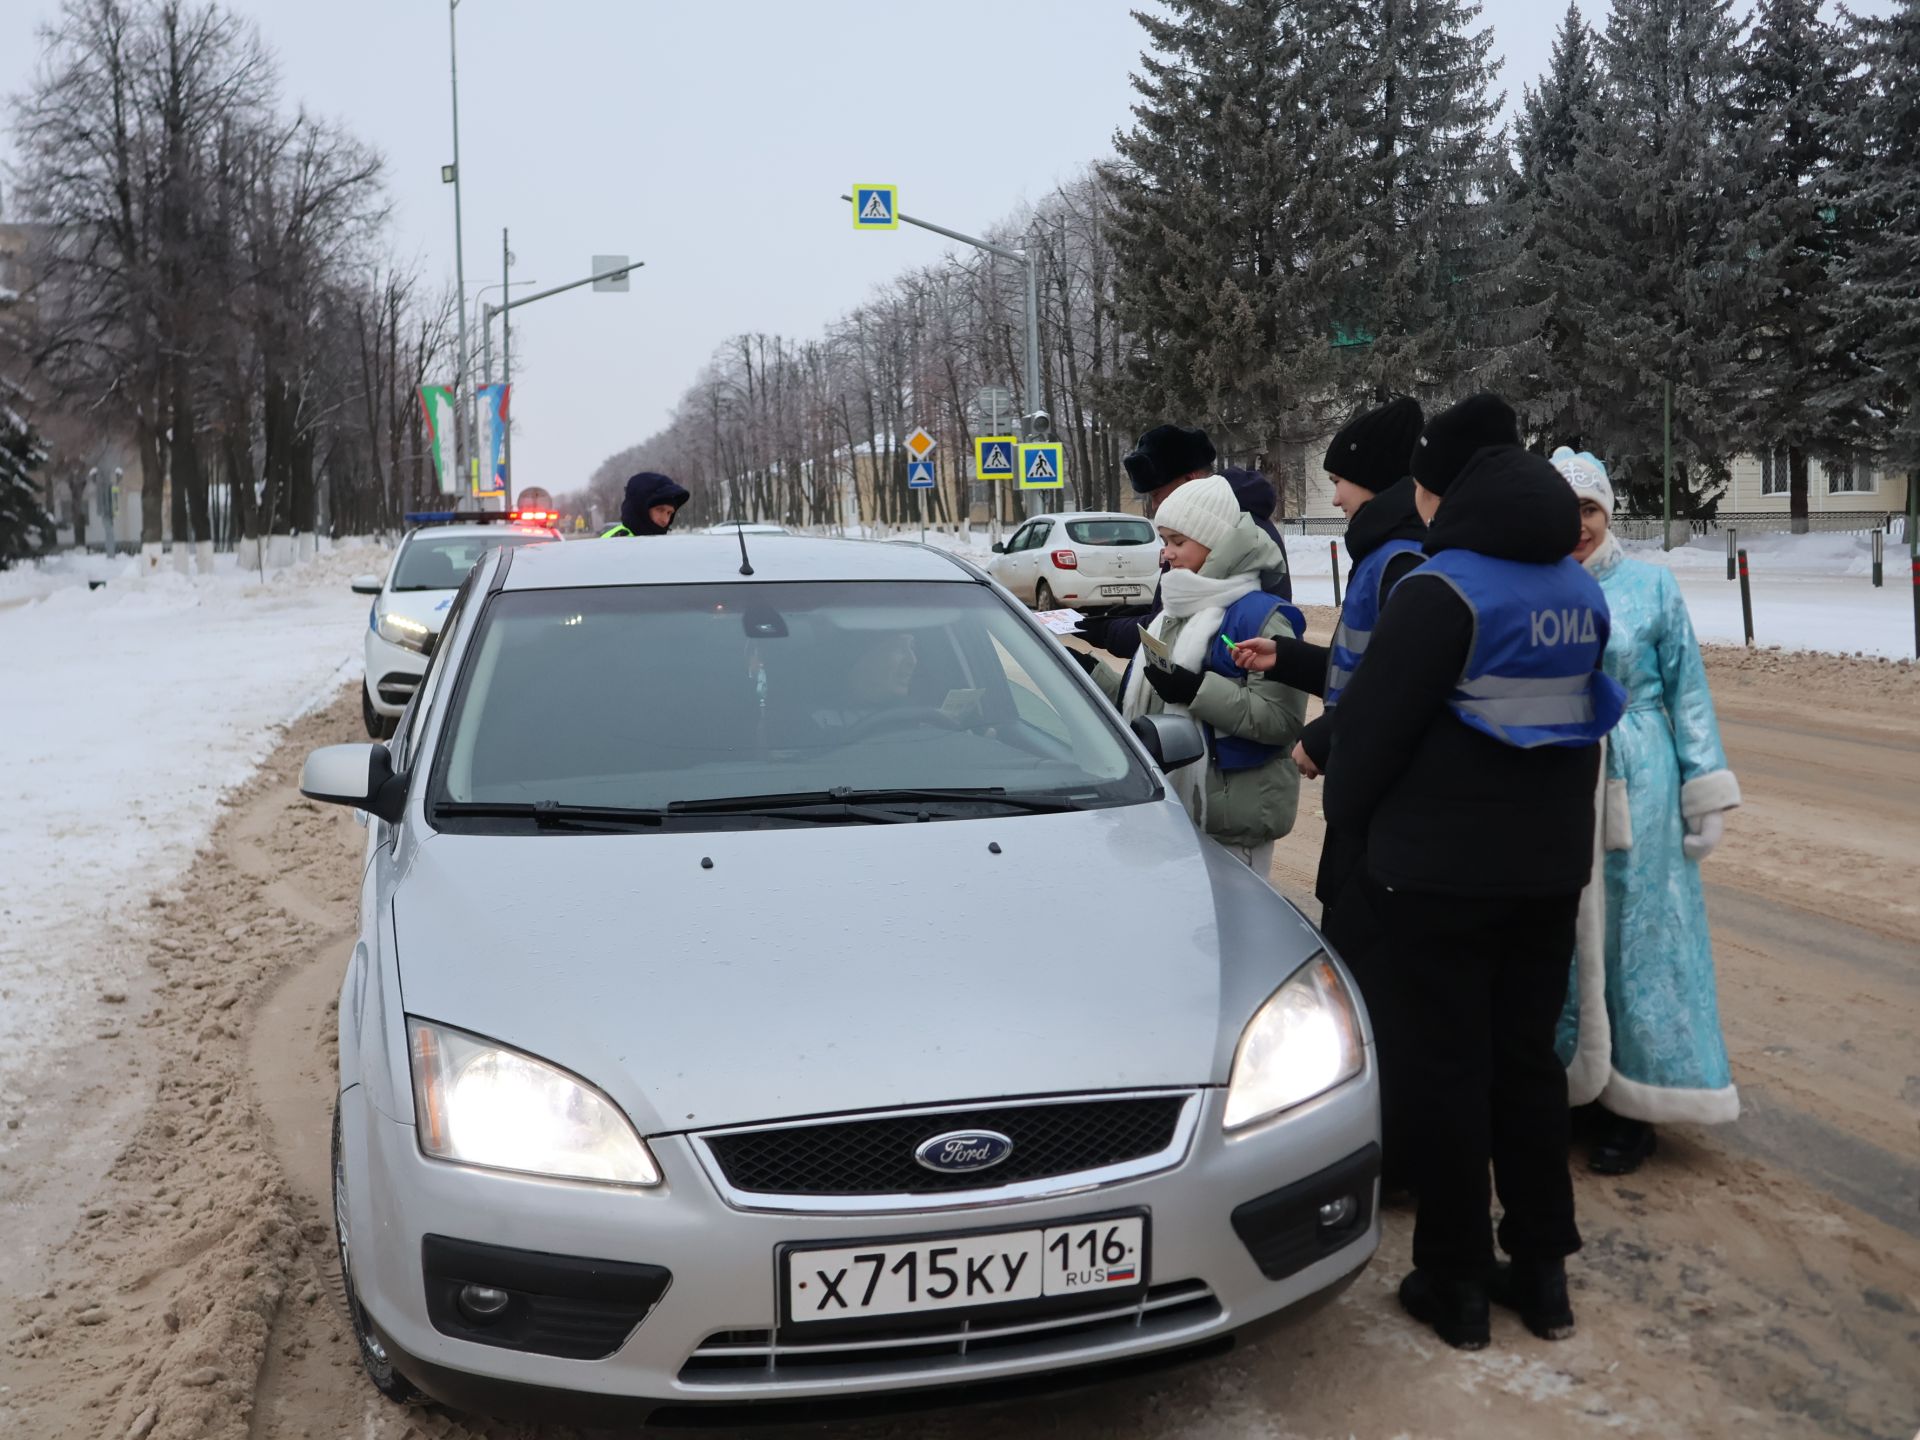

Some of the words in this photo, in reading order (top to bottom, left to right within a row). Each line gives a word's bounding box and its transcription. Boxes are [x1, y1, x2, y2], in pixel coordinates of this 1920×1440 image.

[1530, 607, 1598, 647] ЮИД
[940, 1139, 991, 1163] Ford
[816, 1247, 1029, 1311] Х715КУ
[1049, 1226, 1125, 1271] 116
[1066, 1268, 1105, 1287] RUS
